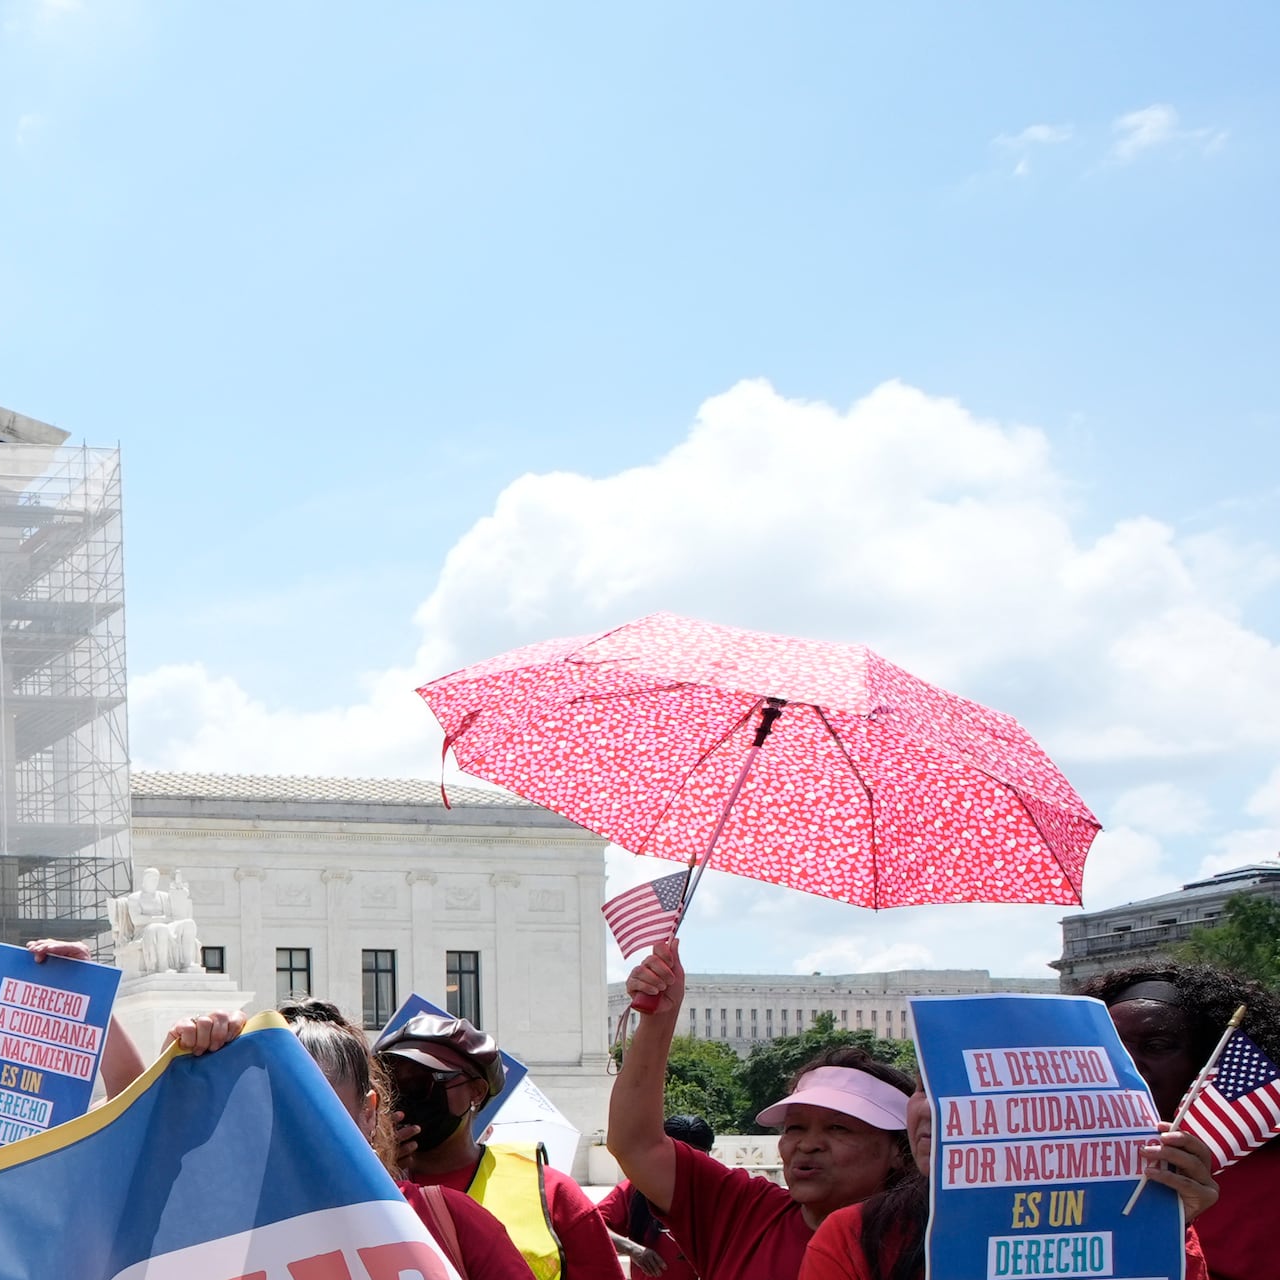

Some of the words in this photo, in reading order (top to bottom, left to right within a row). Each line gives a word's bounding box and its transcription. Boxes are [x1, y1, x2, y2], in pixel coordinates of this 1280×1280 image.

[3, 981, 18, 1003] EL
[20, 985, 82, 1017] DERECHO
[9, 1010, 97, 1051] CIUDADANÍA
[0, 1036, 91, 1077] NACIMIENTO
[973, 1052, 1004, 1087] EL
[1004, 1049, 1108, 1086] DERECHO
[0, 1064, 19, 1088] ES
[20, 1070, 43, 1094] UN
[946, 1101, 964, 1136] A
[969, 1099, 999, 1136] LA
[1006, 1088, 1156, 1134] CIUDADANÍA
[948, 1147, 996, 1185] POR
[1011, 1192, 1042, 1229] ES
[1048, 1190, 1085, 1228] UN
[994, 1236, 1104, 1276] DERECHO
